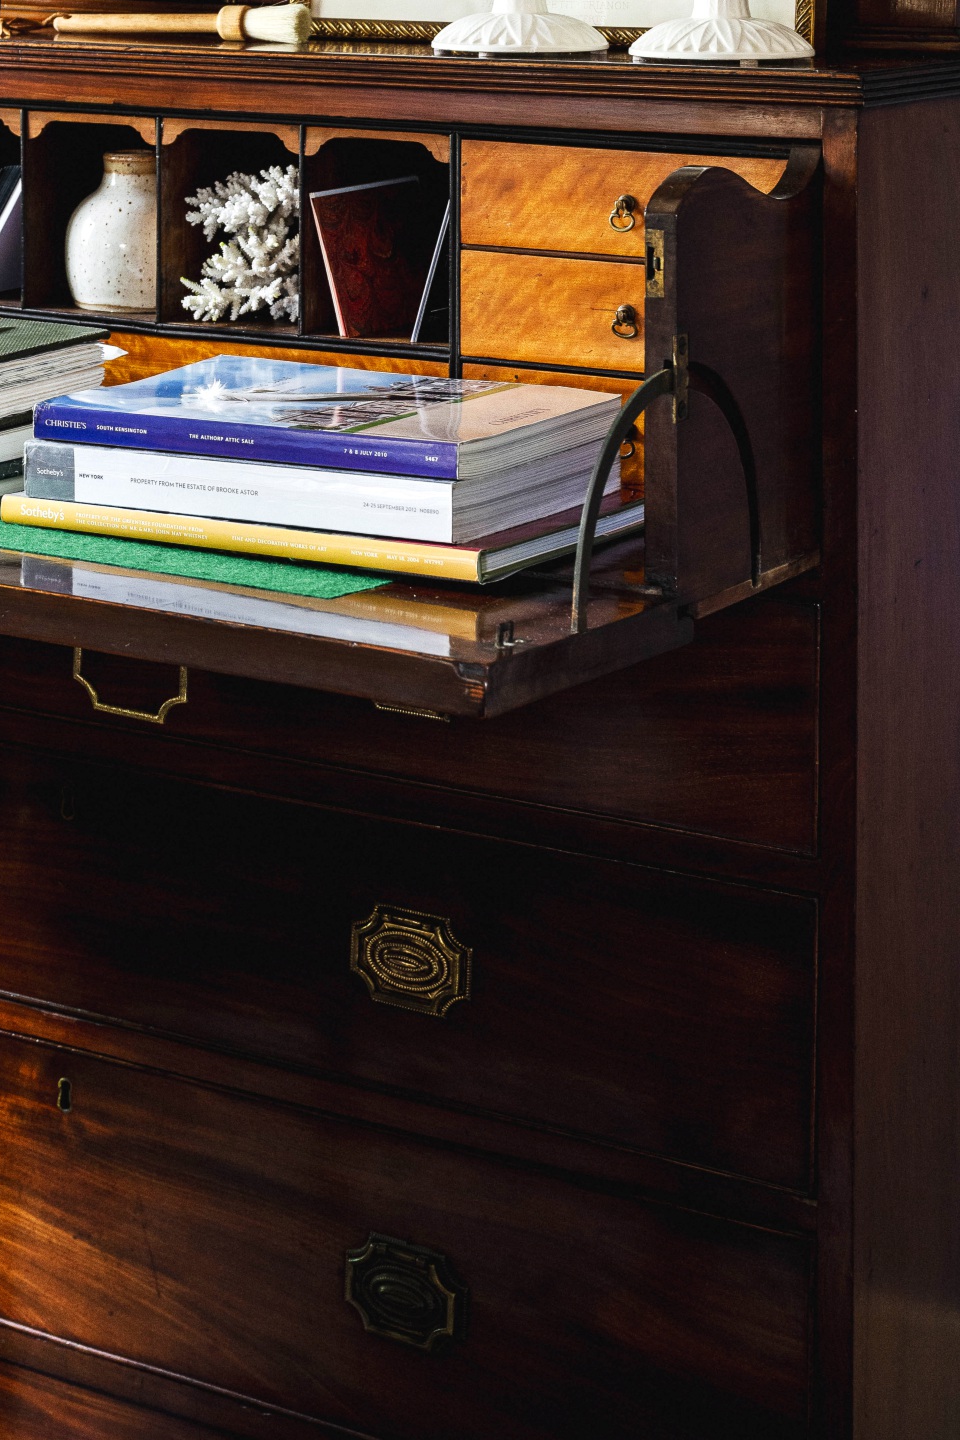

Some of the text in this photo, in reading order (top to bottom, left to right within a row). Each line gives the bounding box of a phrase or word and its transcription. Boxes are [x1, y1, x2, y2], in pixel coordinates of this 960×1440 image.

[45, 419, 87, 430] CHRISTIE'S
[96, 424, 148, 435] SOUTH KENSINGTON
[36, 467, 64, 477] Sotheby's
[130, 477, 157, 486] PROPERTY
[159, 480, 174, 488] FROM
[187, 483, 206, 491] ESTATE
[216, 486, 239, 494] BROOKE
[240, 489, 259, 497] ASTOR
[20, 504, 65, 522] Sotheby's
[377, 503, 405, 512] SEPTEMBER
[363, 551, 378, 559] YORK
